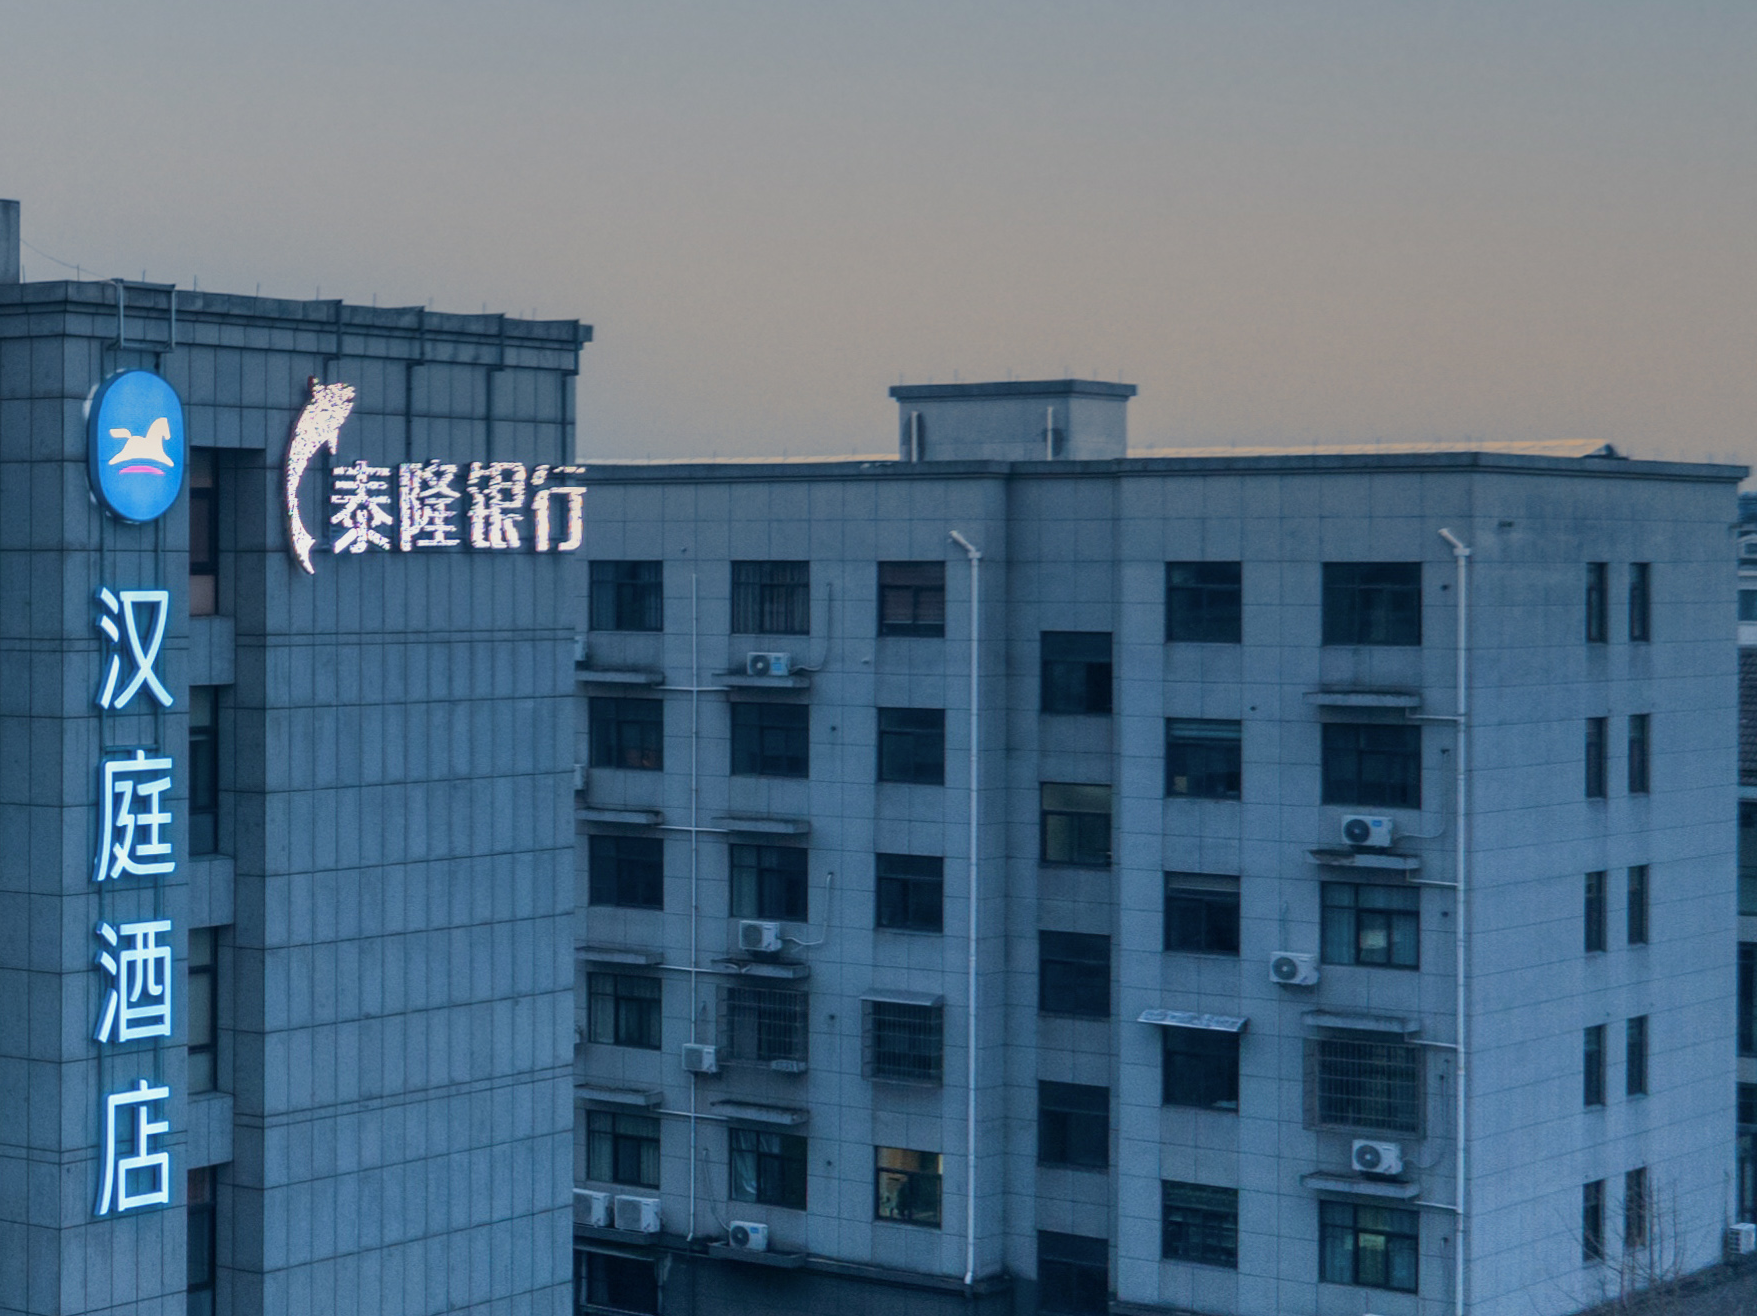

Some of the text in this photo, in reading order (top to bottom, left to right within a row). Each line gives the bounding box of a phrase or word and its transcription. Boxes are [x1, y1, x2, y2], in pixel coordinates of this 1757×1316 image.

[331, 459, 587, 554] 泰隆银行
[93, 587, 175, 1216] 汉庭酒店
